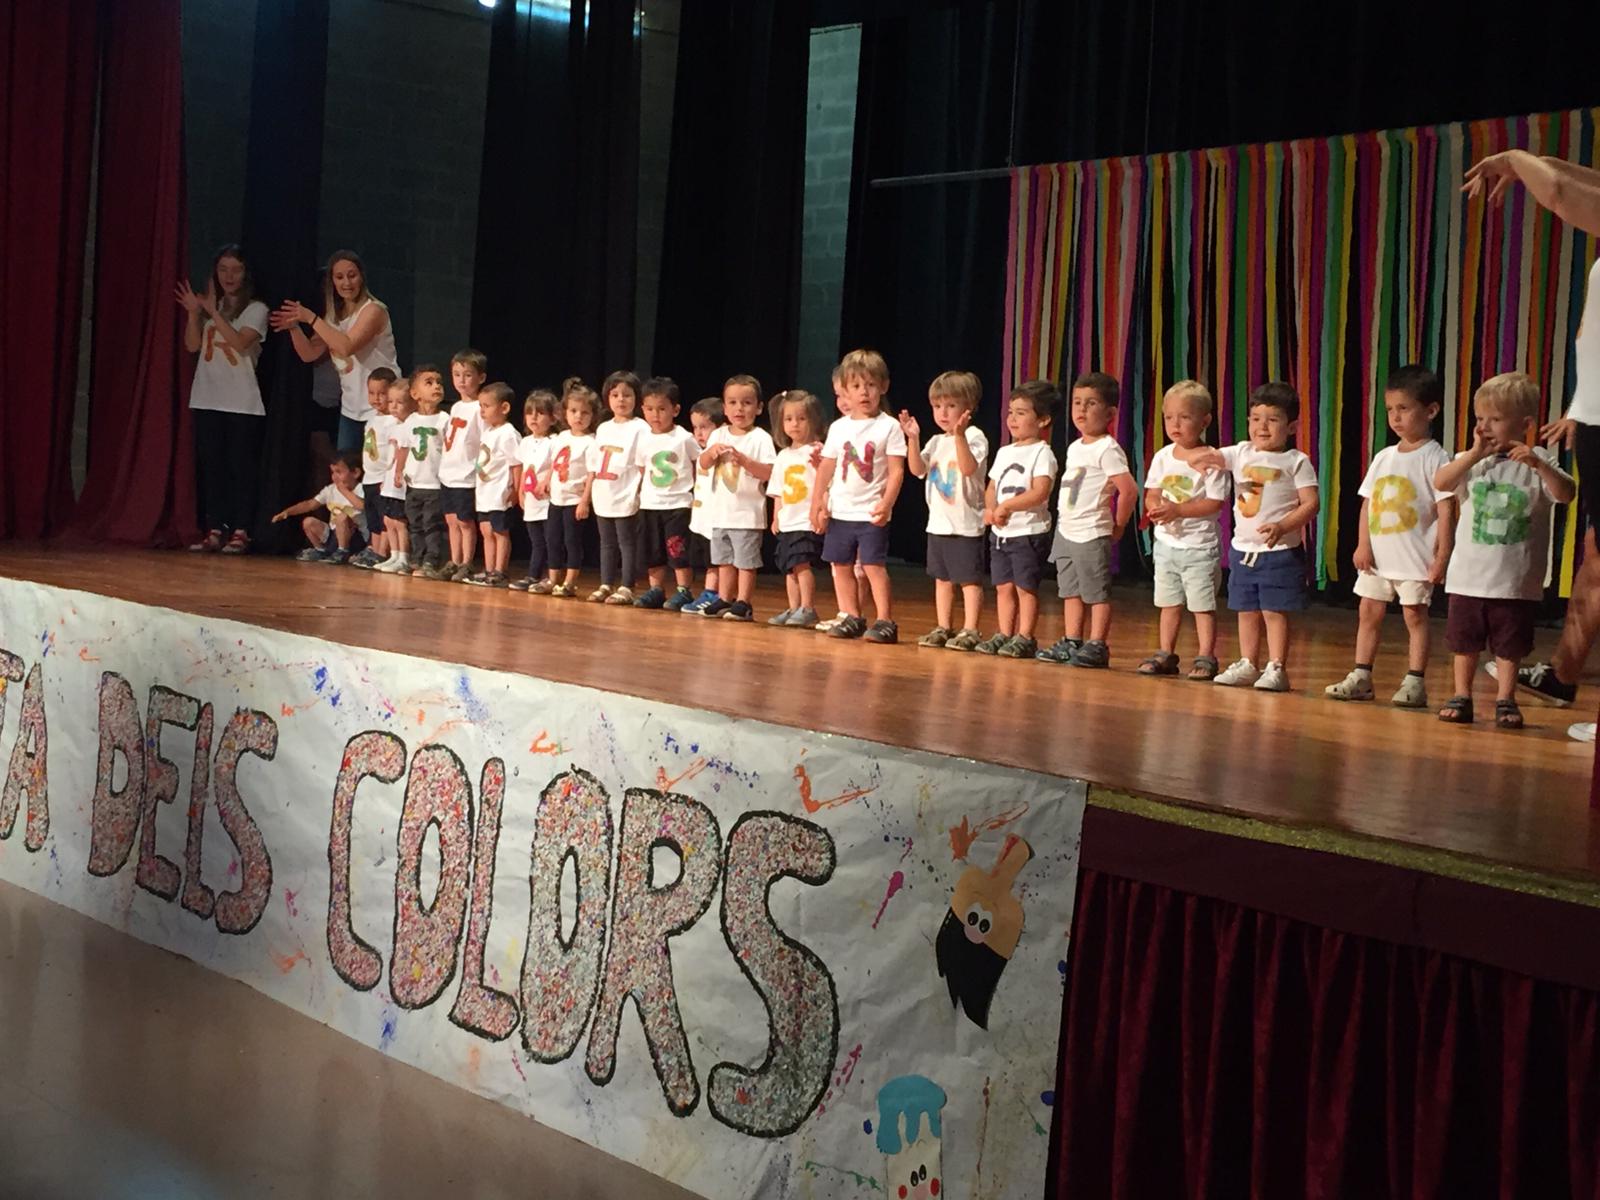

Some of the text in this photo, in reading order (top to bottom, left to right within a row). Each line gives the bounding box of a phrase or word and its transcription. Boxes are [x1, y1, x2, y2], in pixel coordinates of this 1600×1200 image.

[412, 426, 438, 461] J
[596, 444, 624, 480] I
[842, 440, 876, 483] N
[650, 450, 679, 488] S
[783, 464, 808, 504] S
[927, 459, 957, 505] N
[1238, 464, 1281, 518] J
[1369, 474, 1419, 535] B
[1472, 481, 1529, 545] B
[88, 670, 278, 934] DELS
[326, 730, 838, 1137] COLORS
